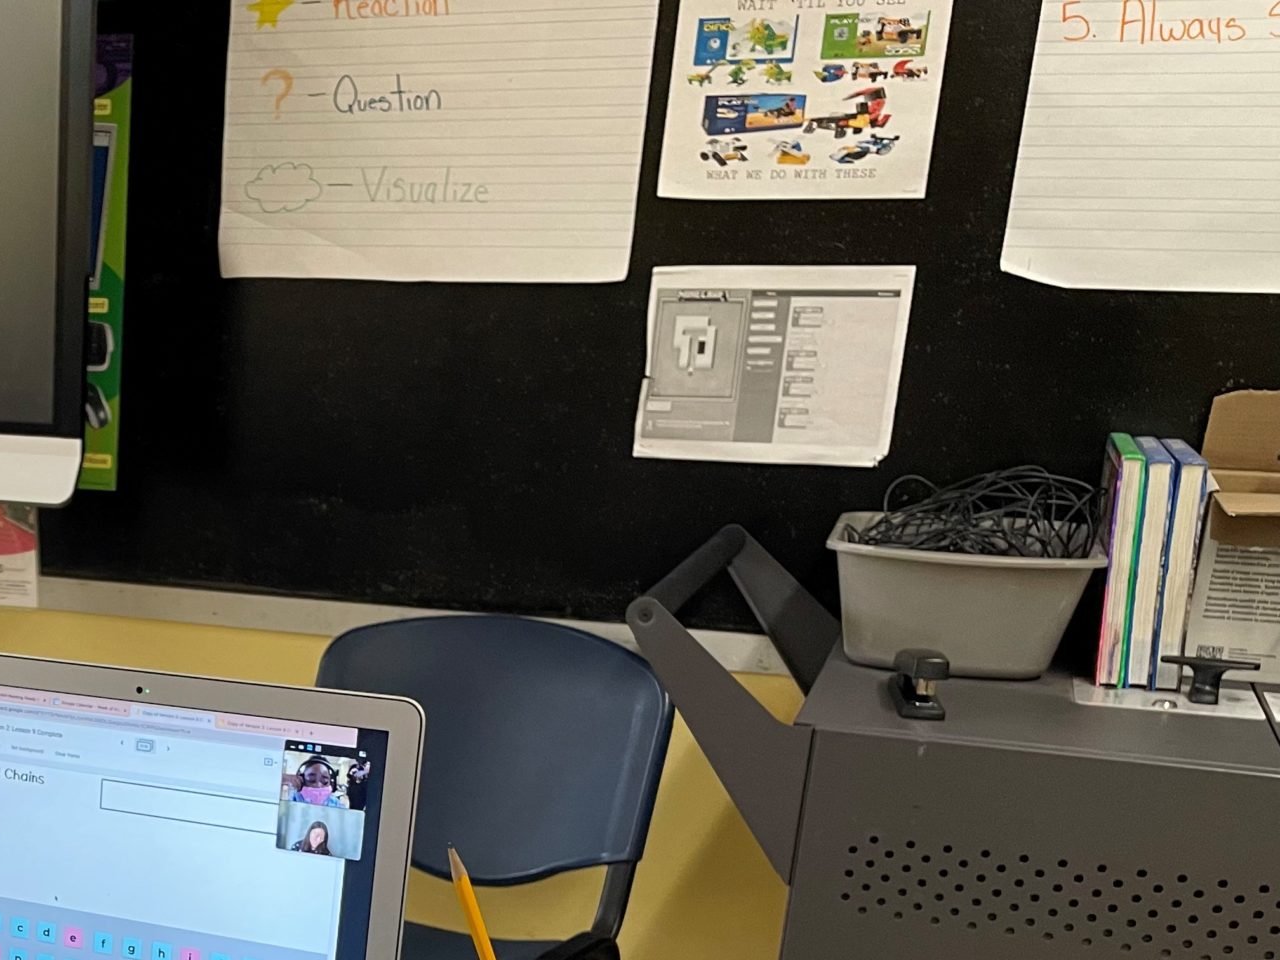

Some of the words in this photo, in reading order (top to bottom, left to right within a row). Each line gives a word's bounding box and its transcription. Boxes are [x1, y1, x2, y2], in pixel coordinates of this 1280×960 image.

[1062, 1, 1097, 42] 5.
[1120, 0, 1247, 45] Always
[333, 73, 443, 115] Question
[360, 165, 490, 205] Visualize
[706, 169, 739, 180] WHAT
[746, 169, 763, 180] WE
[770, 169, 787, 180] DO
[794, 169, 827, 180] WITH
[835, 168, 878, 179] THESE
[4, 768, 45, 785] Chains
